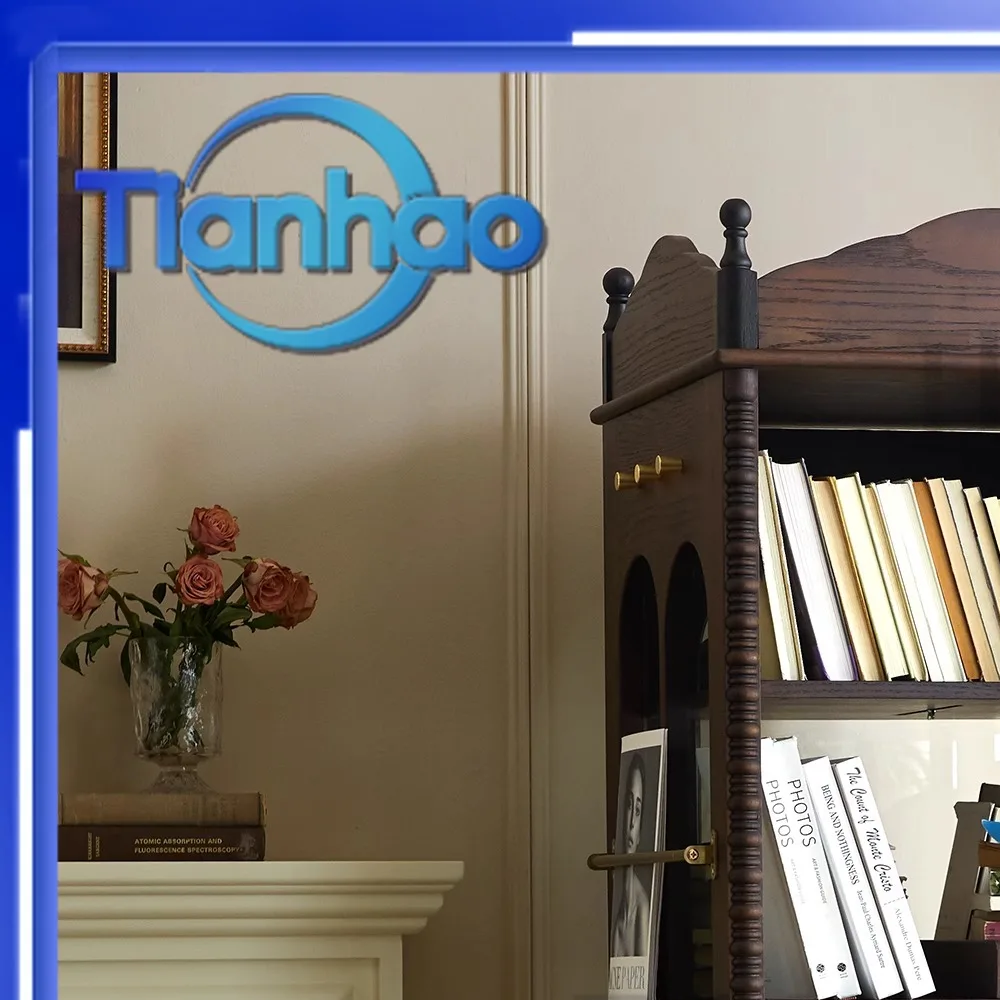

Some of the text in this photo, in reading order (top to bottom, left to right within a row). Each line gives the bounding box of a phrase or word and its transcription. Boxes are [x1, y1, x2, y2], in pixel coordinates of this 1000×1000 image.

[766, 780, 794, 848] PHOTOS
[787, 779, 816, 848] PHOTOS
[821, 784, 860, 886] BEING AND NOTHINGNESS
[846, 767, 892, 892] The Count of Monte Cristo
[895, 908, 909, 941] Alexandre
[905, 941, 916, 965] Dumas
